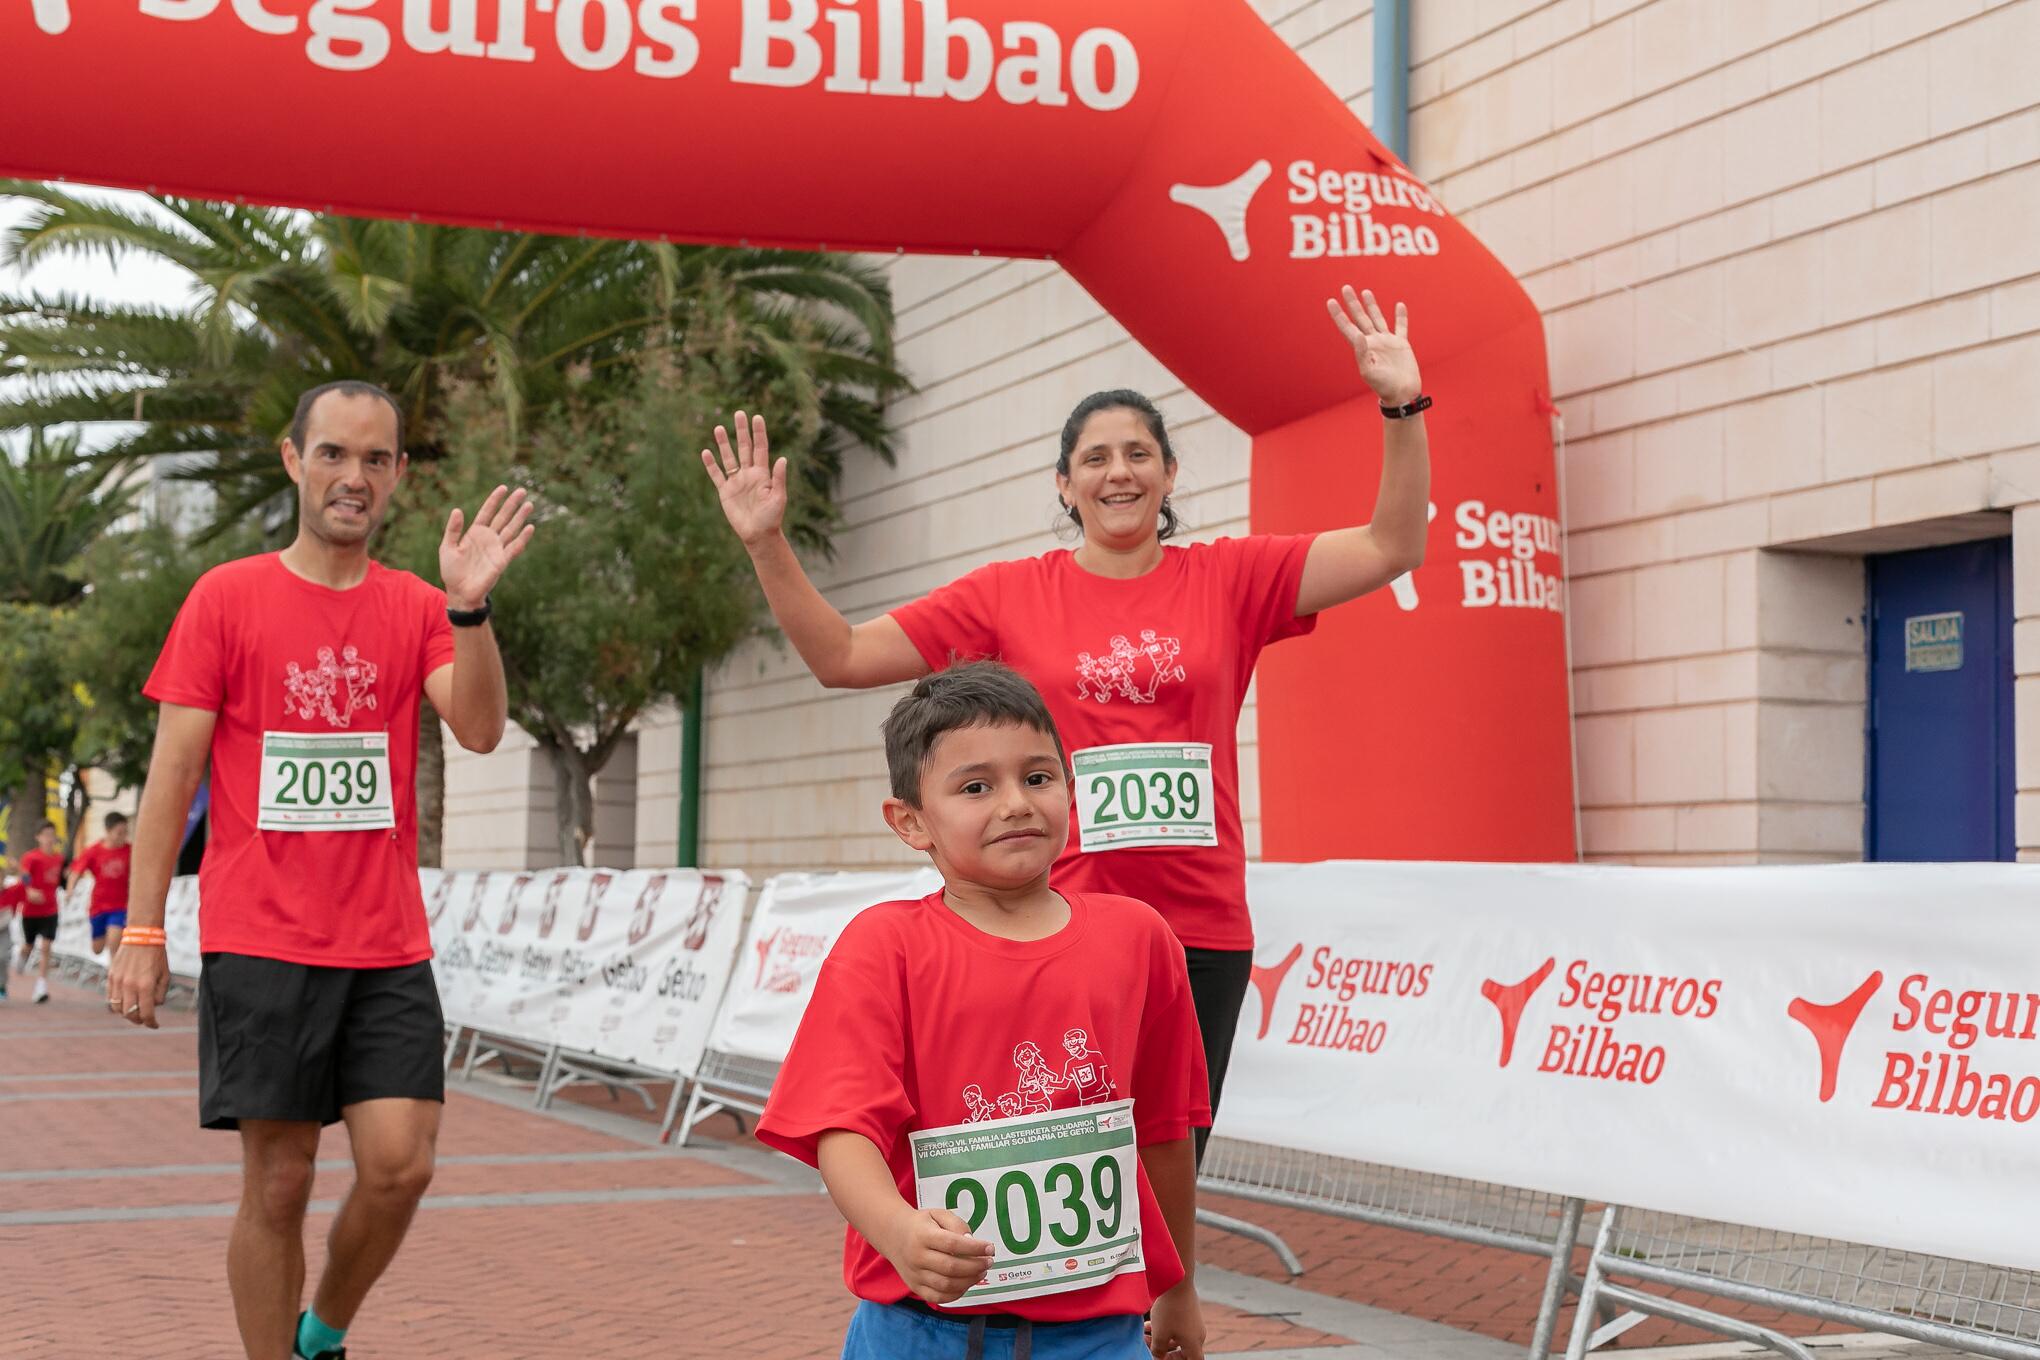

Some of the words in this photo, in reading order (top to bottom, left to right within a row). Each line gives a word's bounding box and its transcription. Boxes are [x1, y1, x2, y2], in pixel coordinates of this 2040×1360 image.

[139, 0, 700, 79] guros
[729, 0, 1140, 111] Bilbao
[1287, 160, 1446, 217] Seguros
[1289, 211, 1440, 259] Bilbao
[275, 760, 377, 805] 2039
[1090, 771, 1200, 825] 2039
[1306, 946, 1434, 1002] Seguros
[1557, 959, 1722, 1022] Seguros
[1287, 1003, 1387, 1053] Bilbao
[1537, 1024, 1665, 1084] Bilbao
[1871, 1051, 2040, 1123] Bilbao
[918, 1150, 929, 1159] VII
[929, 1146, 970, 1157] CARRERA
[971, 1140, 1010, 1152] FAMILIAR
[1011, 1133, 1056, 1146] SOLIDARIA
[1057, 1130, 1069, 1139] DE
[1070, 1126, 1095, 1136] GETXO
[969, 1134, 1000, 1145] FAMILIA
[1001, 1126, 1050, 1140] LASTERKETA
[1051, 1119, 1095, 1132] SOLIDARIOA
[945, 1154, 1122, 1255] 2039
[1008, 1270, 1032, 1278] Getxo
